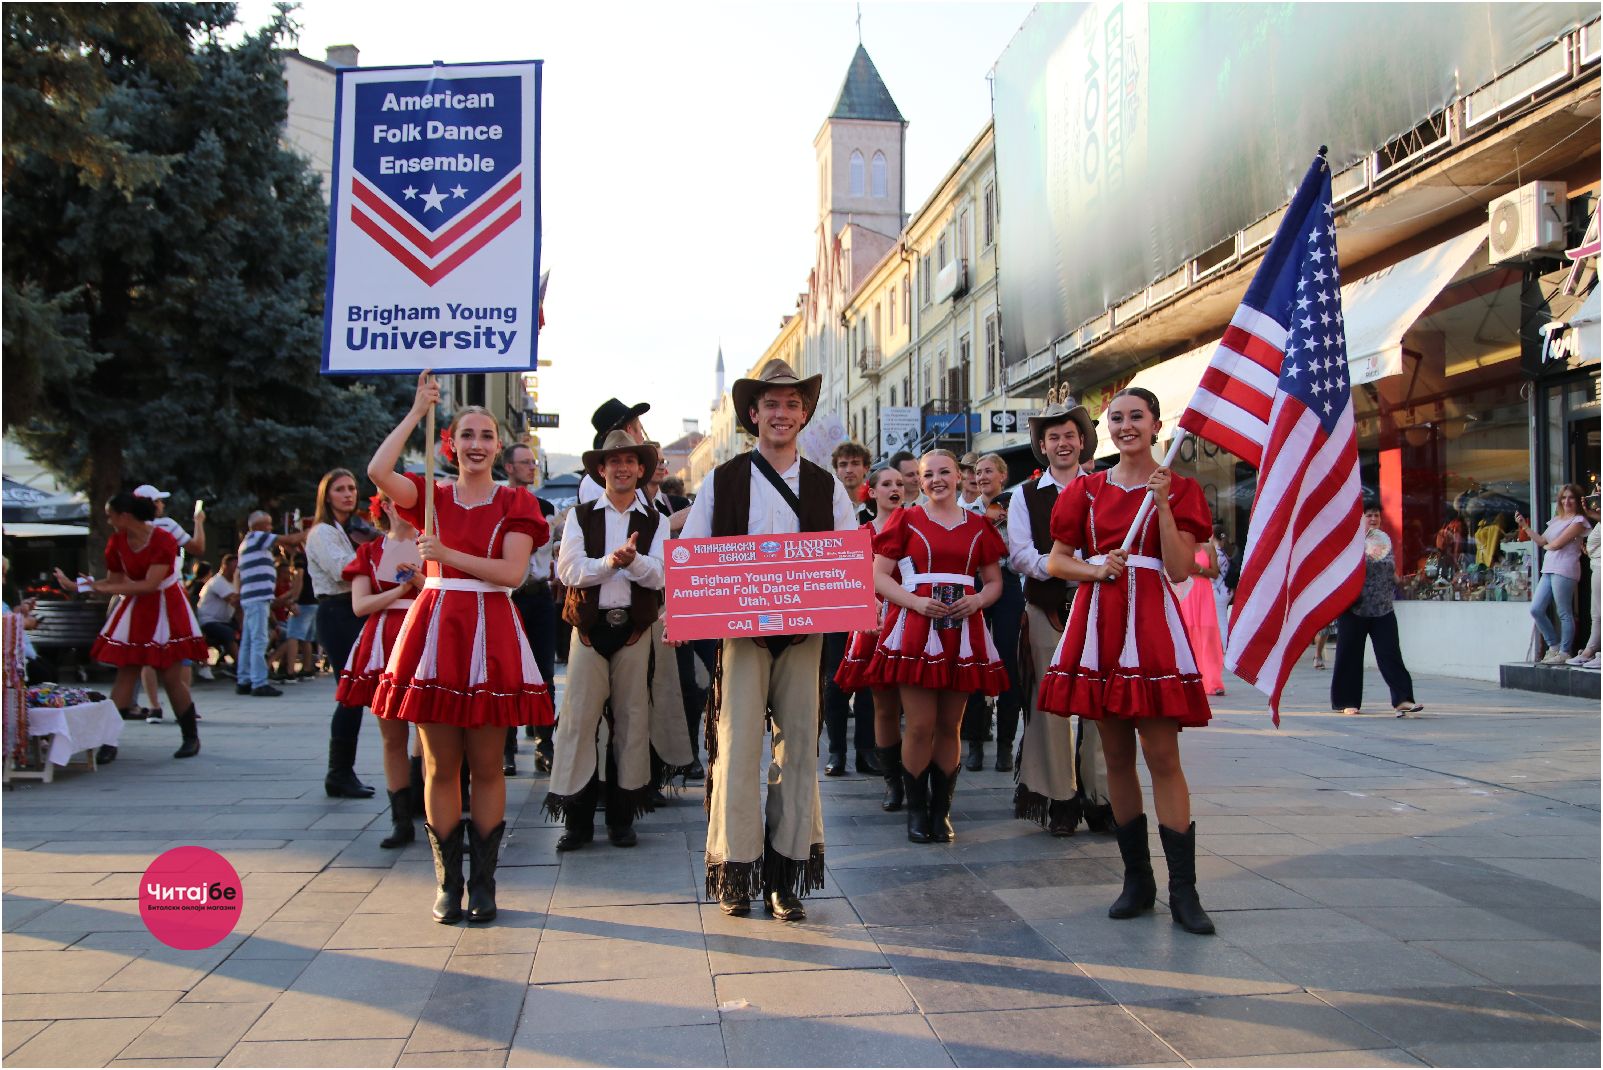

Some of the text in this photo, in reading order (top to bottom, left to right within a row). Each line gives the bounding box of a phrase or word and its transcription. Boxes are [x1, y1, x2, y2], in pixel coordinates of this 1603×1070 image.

[381, 91, 495, 111] American
[373, 120, 503, 143] Folk Dance
[379, 153, 495, 174] Ensemble
[347, 303, 518, 325] Brigham Young
[346, 324, 518, 354] University
[783, 537, 843, 551] ILINDEN
[783, 547, 824, 559] DAYS
[691, 568, 846, 586] Brigham Young University
[672, 579, 866, 598] American Folk Dance Ensemble,
[738, 594, 801, 607] Utah, USA
[727, 620, 753, 630] САД
[788, 617, 813, 627] USA
